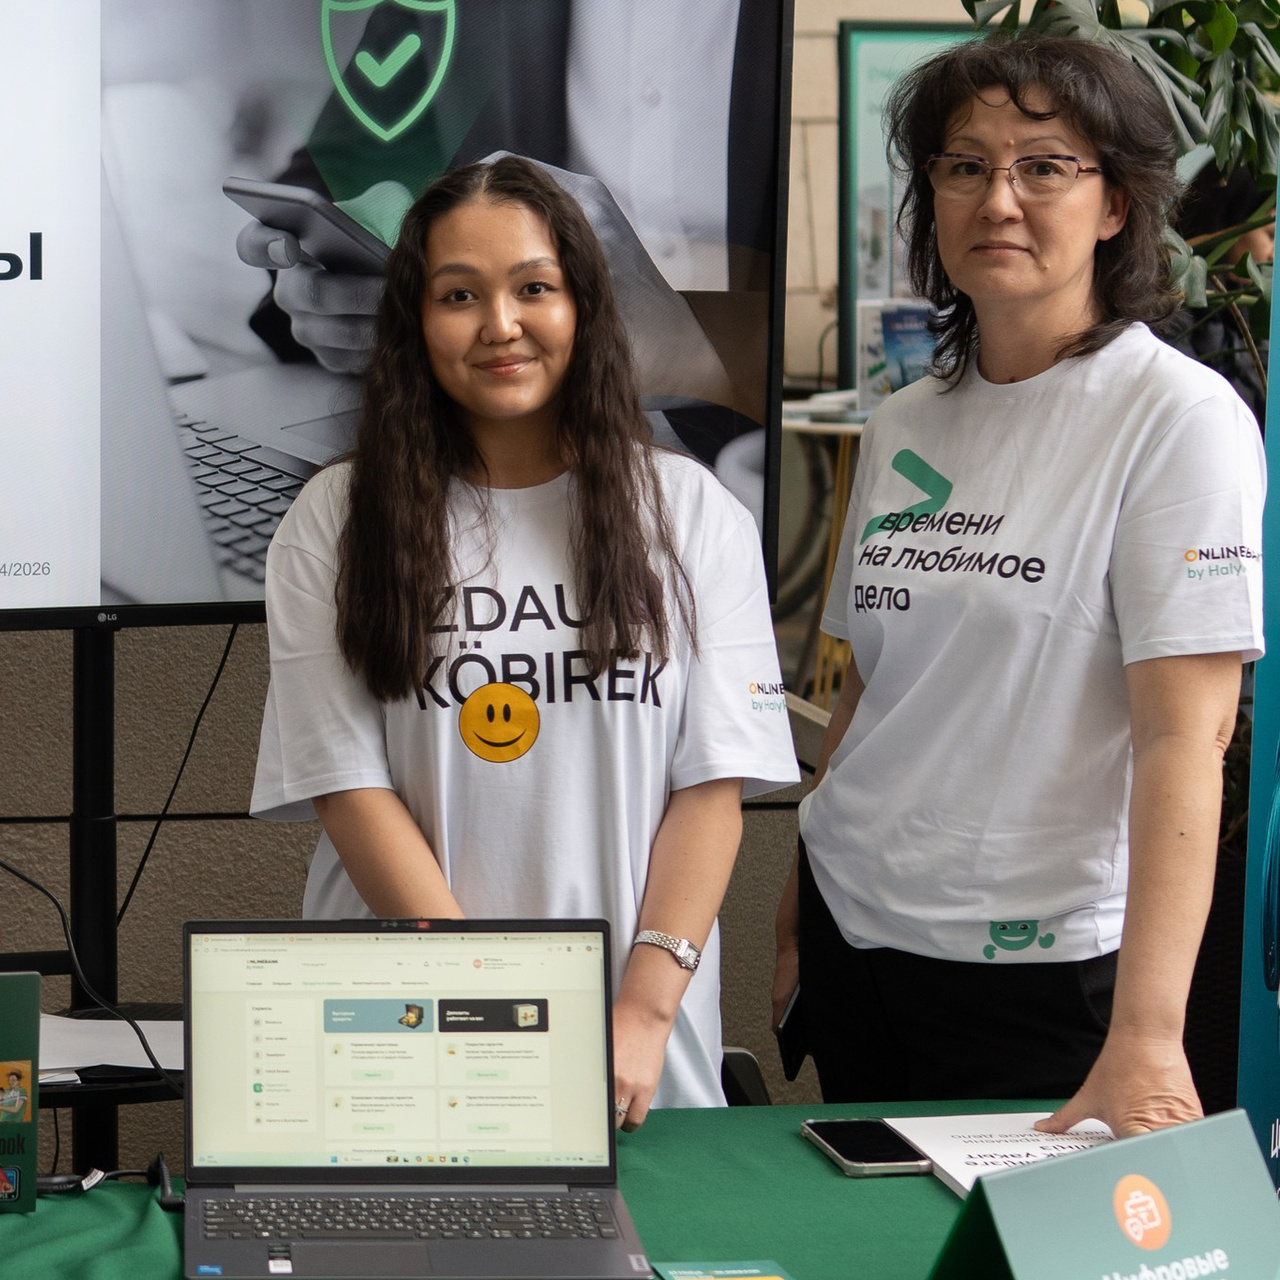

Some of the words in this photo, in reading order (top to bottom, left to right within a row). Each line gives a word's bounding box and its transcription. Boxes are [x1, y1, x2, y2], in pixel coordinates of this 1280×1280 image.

[878, 511, 1005, 539] времени
[858, 545, 892, 567] на
[892, 546, 1046, 583] любимое
[1187, 566, 1204, 580] by
[854, 584, 911, 613] дело
